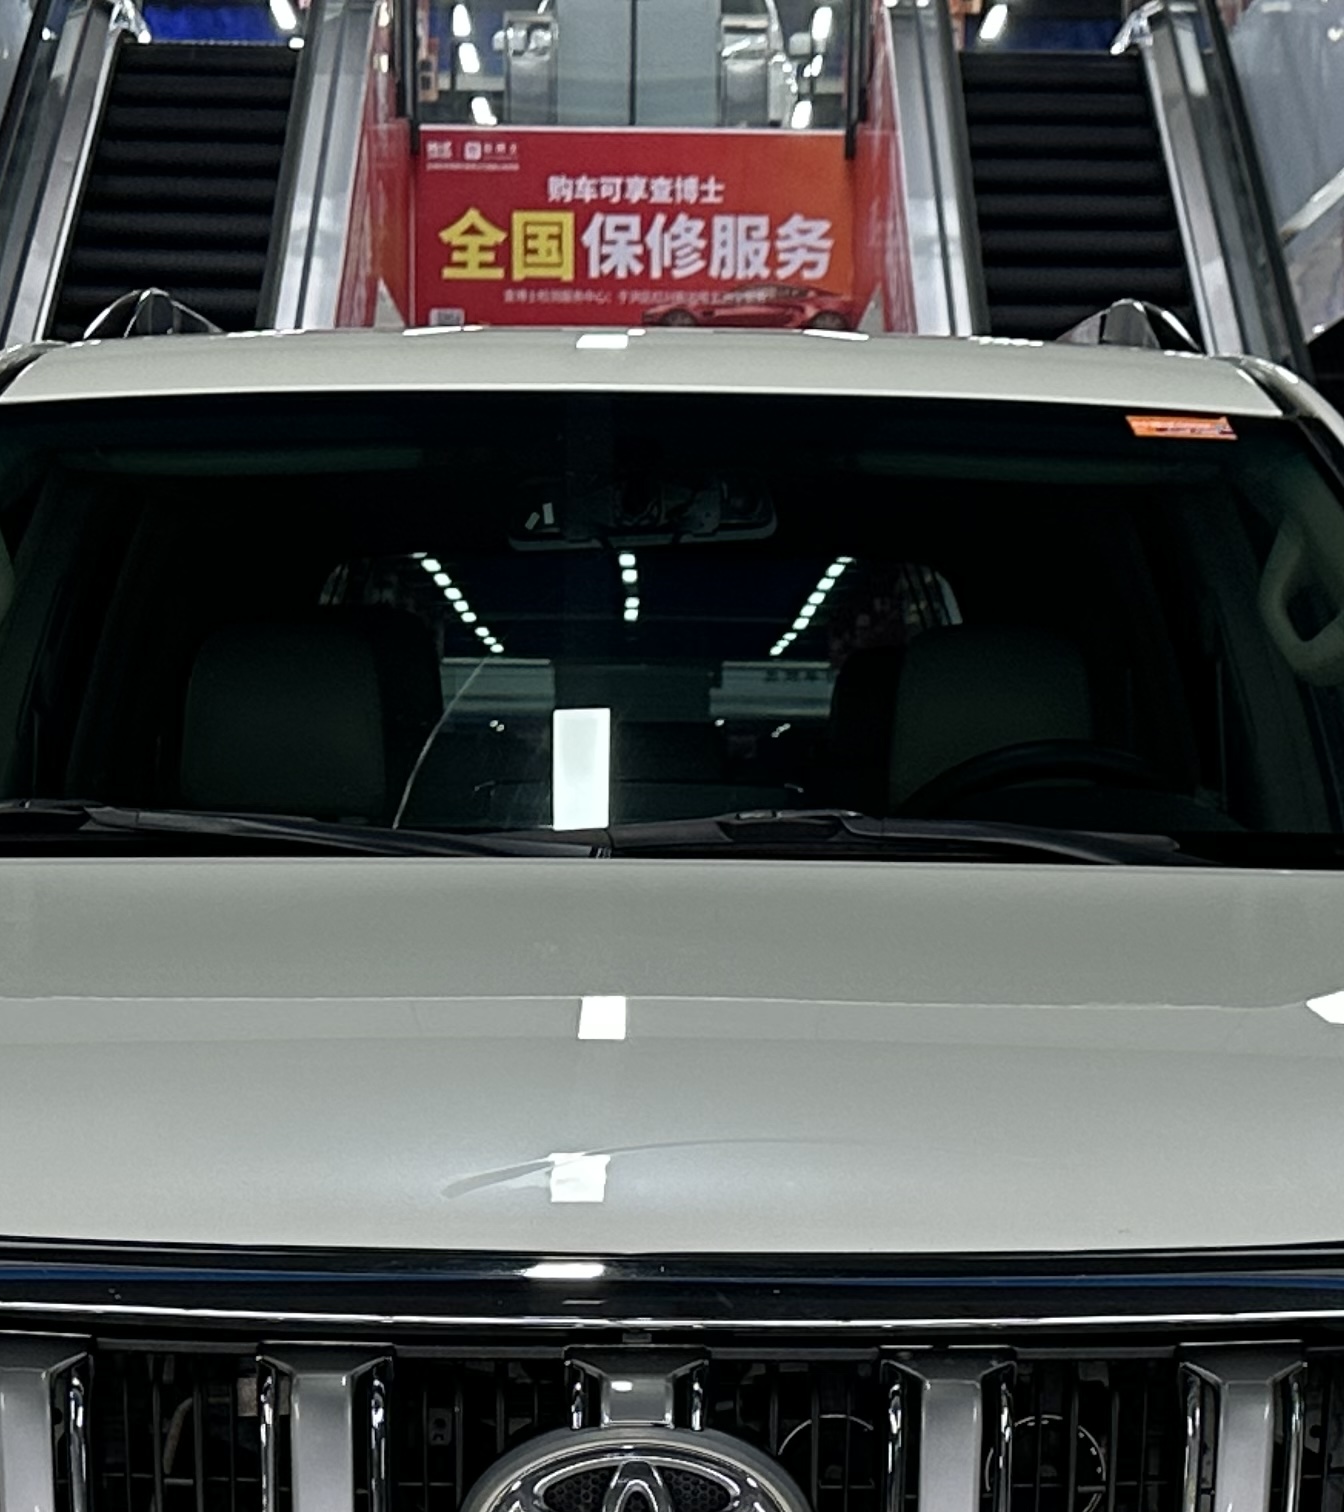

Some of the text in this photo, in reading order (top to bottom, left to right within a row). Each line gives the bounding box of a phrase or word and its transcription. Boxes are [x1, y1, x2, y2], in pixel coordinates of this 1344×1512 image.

[547, 174, 725, 205] 购车可享查博士
[437, 207, 835, 283] 全国保修服务
